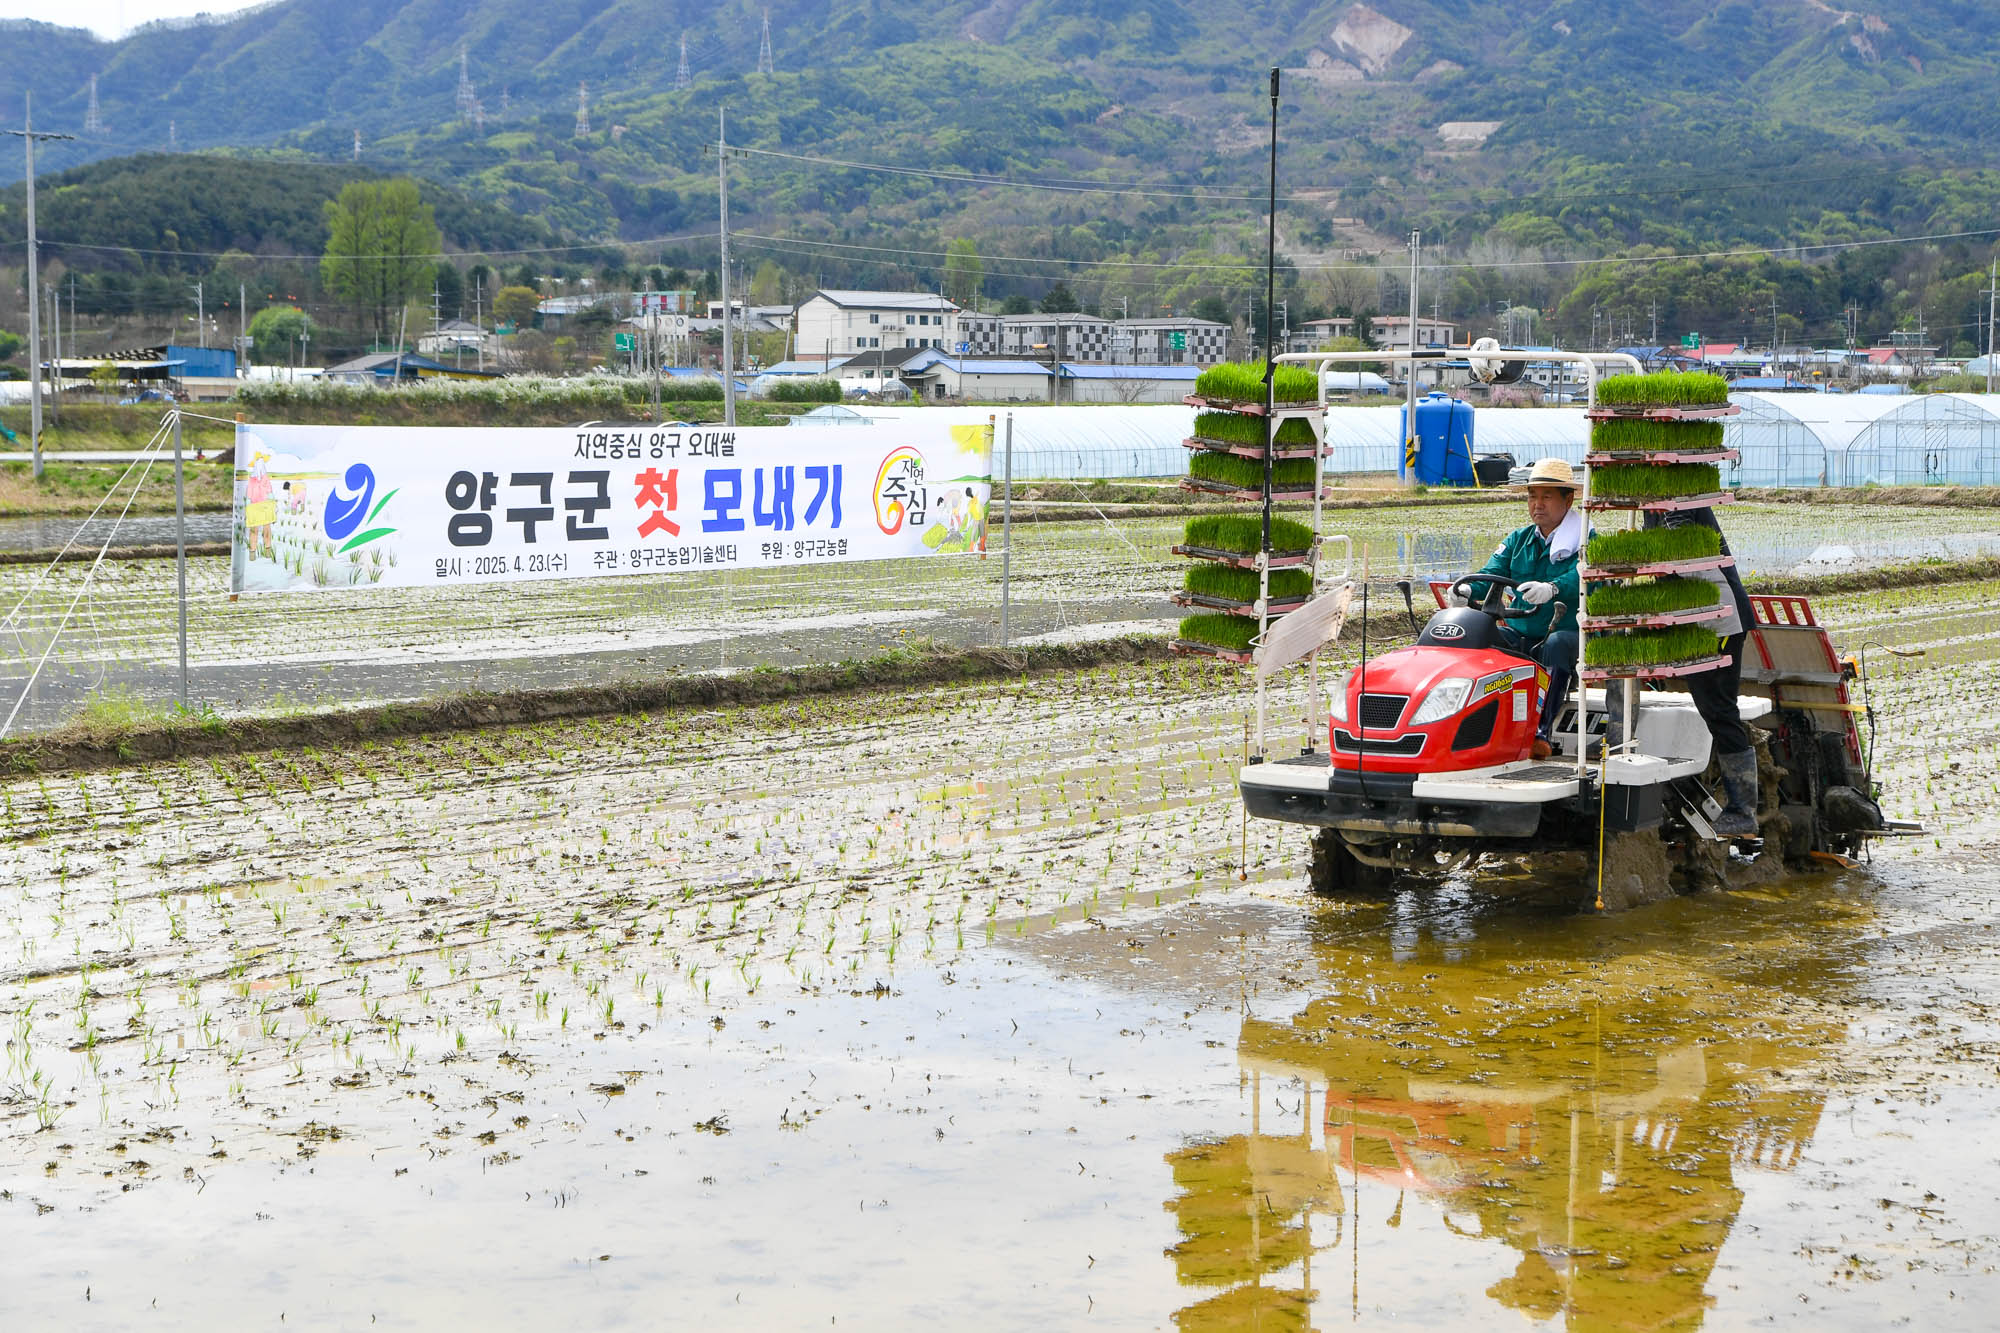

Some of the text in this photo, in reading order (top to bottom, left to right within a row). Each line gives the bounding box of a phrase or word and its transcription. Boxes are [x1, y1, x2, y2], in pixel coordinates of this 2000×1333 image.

[574, 432, 736, 459] 자연중심 양구 오대쌀
[902, 458, 924, 486] 자연
[445, 464, 843, 547] 양구군 첫 모내기
[882, 477, 927, 526] 중심
[593, 550, 618, 570] 주관
[630, 544, 737, 568] 양구군농업기술센터
[761, 541, 783, 560] 후원
[794, 538, 848, 559] 양구군농협
[435, 557, 462, 578] 일시
[475, 556, 510, 575] 2025.
[513, 555, 525, 573] 4.
[1434, 625, 1460, 637] 국제
